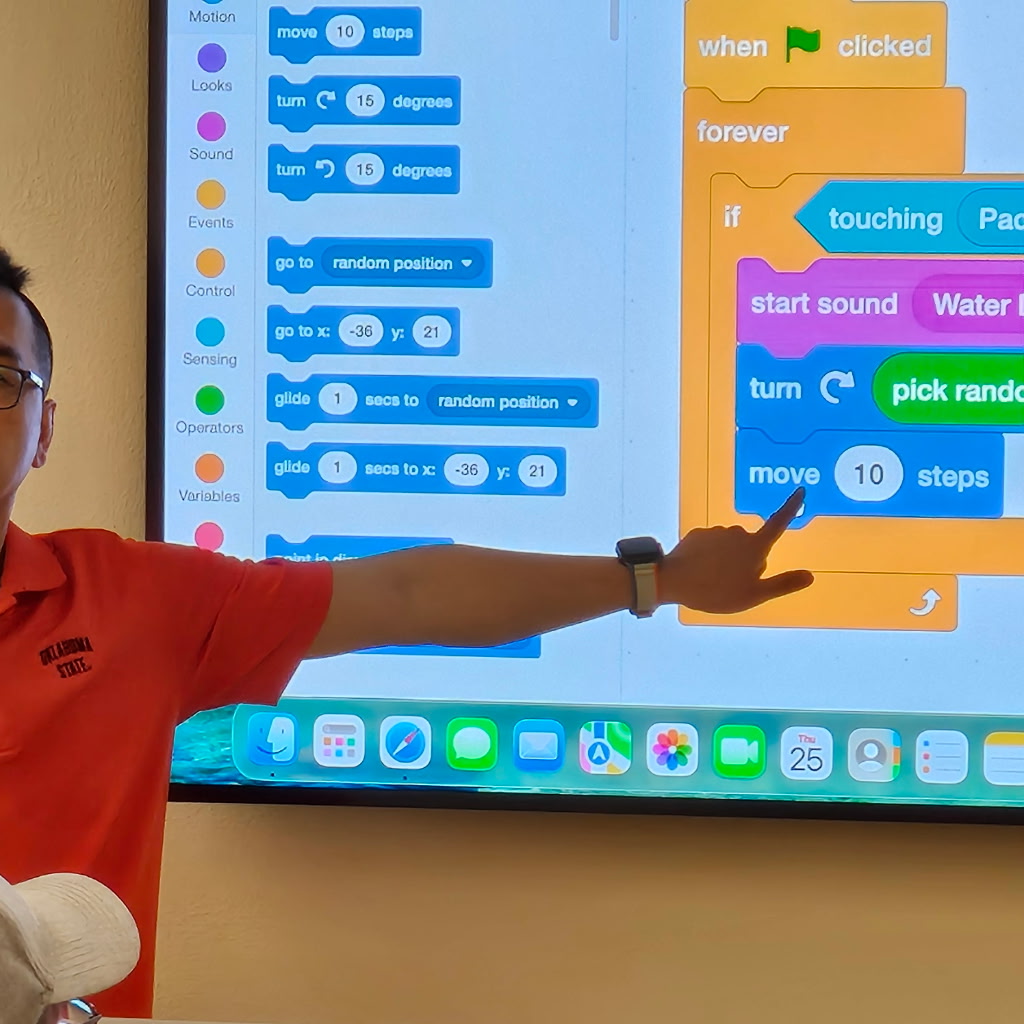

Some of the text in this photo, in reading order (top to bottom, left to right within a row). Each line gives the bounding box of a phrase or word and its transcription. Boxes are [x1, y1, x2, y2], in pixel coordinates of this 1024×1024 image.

[189, 10, 236, 23] Motion
[277, 25, 414, 41] move 10 steps
[698, 34, 932, 58] when clicked
[191, 79, 232, 92] Looks
[276, 94, 453, 111] turn 15 degrees
[696, 119, 789, 144] forever
[189, 148, 233, 161] Sound
[276, 163, 452, 180] turn 15 degrees
[188, 216, 234, 229] Events
[723, 204, 742, 228] if
[829, 207, 943, 235] touching
[275, 256, 453, 274] go to random position
[186, 284, 235, 297] Control
[751, 292, 810, 315] start
[817, 292, 898, 315] sound
[933, 293, 1012, 317] Water
[275, 325, 439, 341] go to x: -36 y: 21
[183, 353, 238, 369] Sensing
[750, 377, 802, 400] turn
[892, 378, 948, 406] pick
[274, 391, 559, 413] glide 1 secs to random position
[176, 421, 244, 437] Operators
[274, 459, 545, 480] glide 1 secs to x: -36 y: 21
[749, 463, 990, 493] move 10 steps
[178, 489, 241, 504] Variables
[798, 734, 817, 744] Thu
[790, 747, 823, 772] 25
